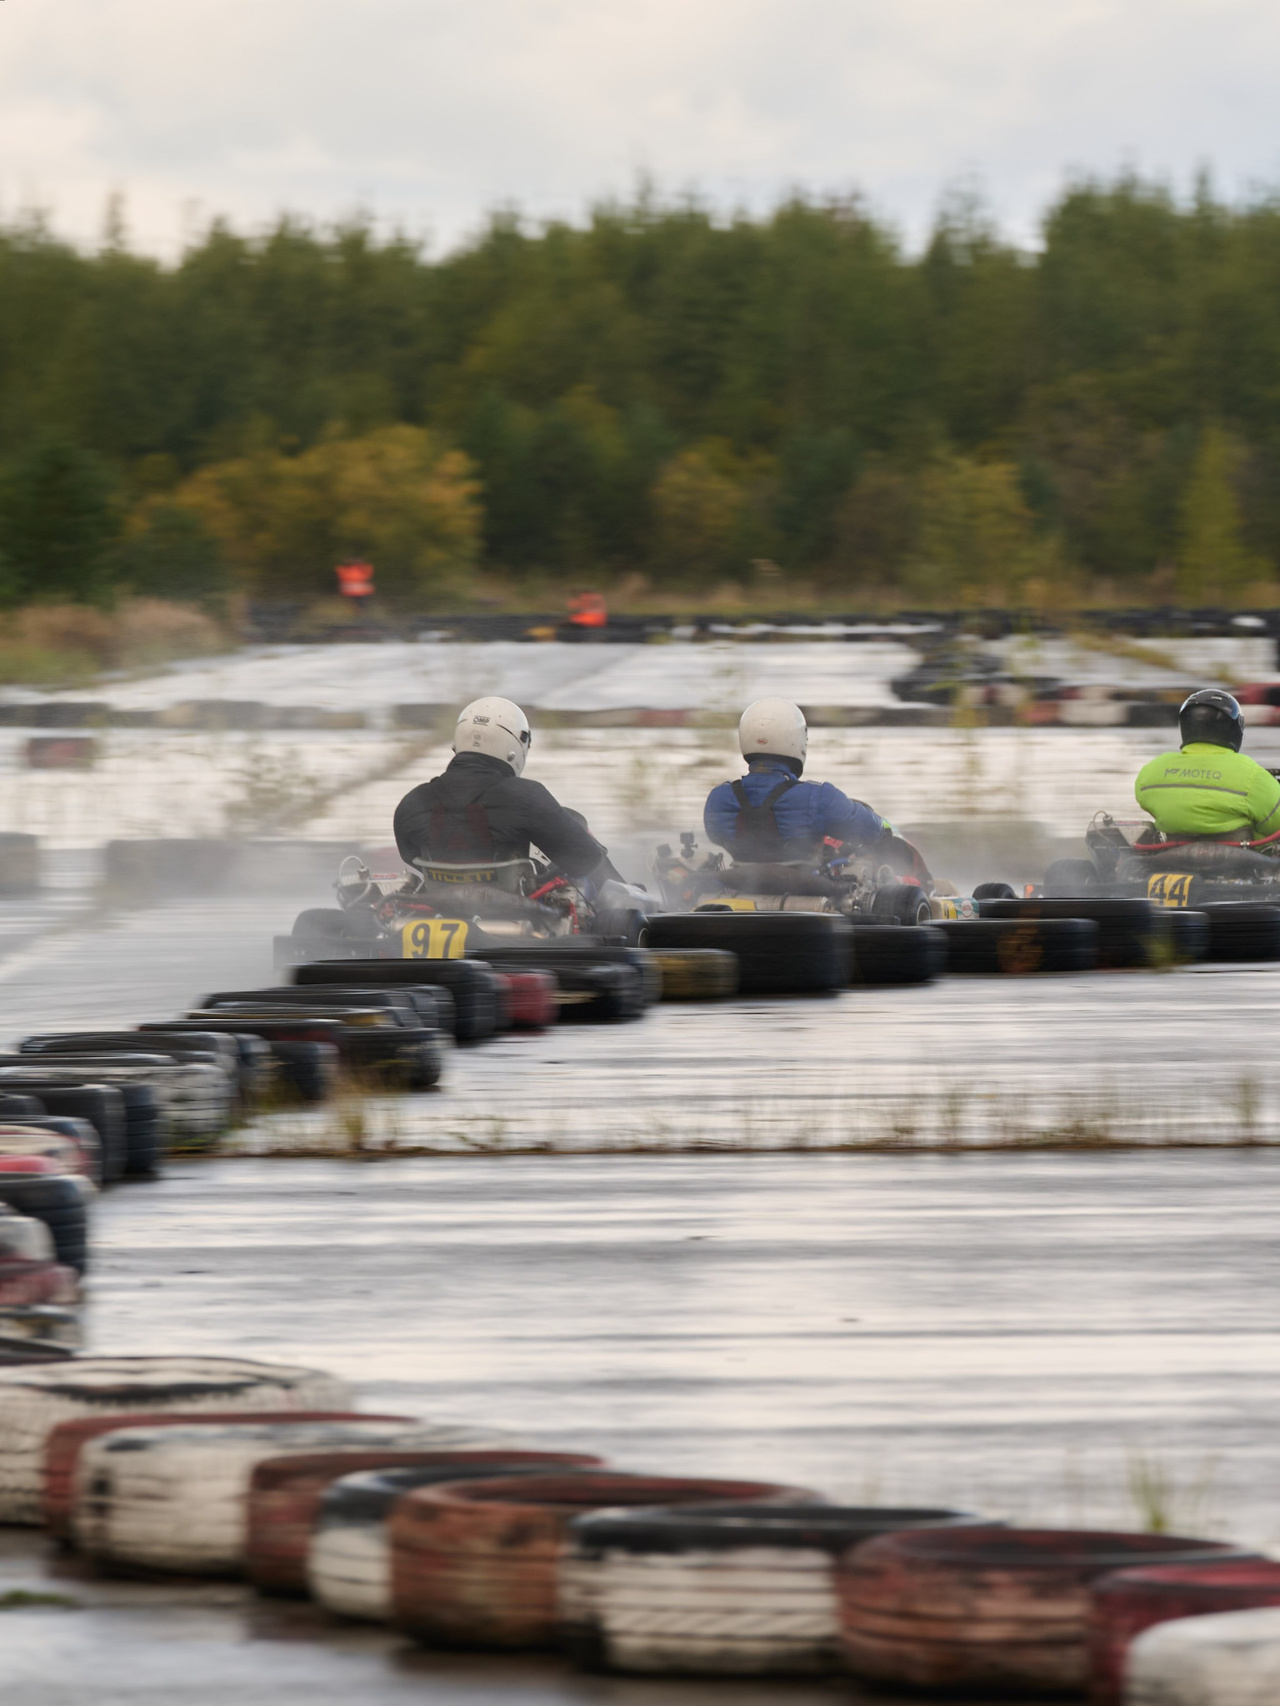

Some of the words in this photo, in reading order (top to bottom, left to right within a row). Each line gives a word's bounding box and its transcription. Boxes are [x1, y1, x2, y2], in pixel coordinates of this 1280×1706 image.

[1180, 769, 1222, 780] MOTEQ
[429, 869, 495, 883] TILLETT
[1149, 875, 1188, 907] 44
[411, 922, 460, 958] 97
